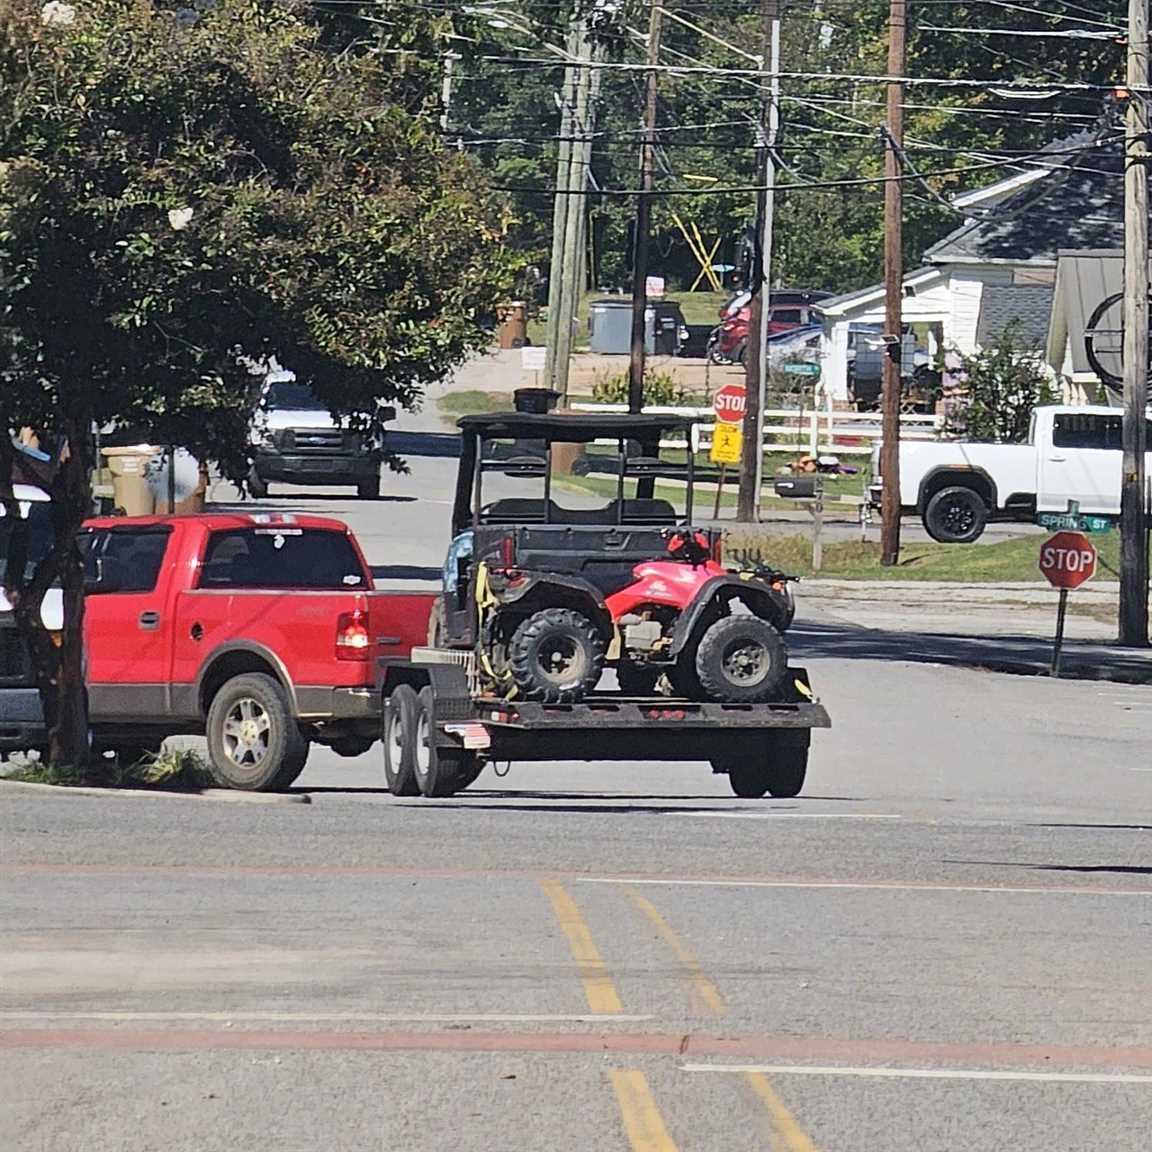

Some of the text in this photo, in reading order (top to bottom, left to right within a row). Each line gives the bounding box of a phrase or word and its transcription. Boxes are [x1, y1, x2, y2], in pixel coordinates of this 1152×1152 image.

[715, 393, 746, 413] STO
[1040, 514, 1107, 530] SPRING ST
[1041, 547, 1094, 572] STOP
